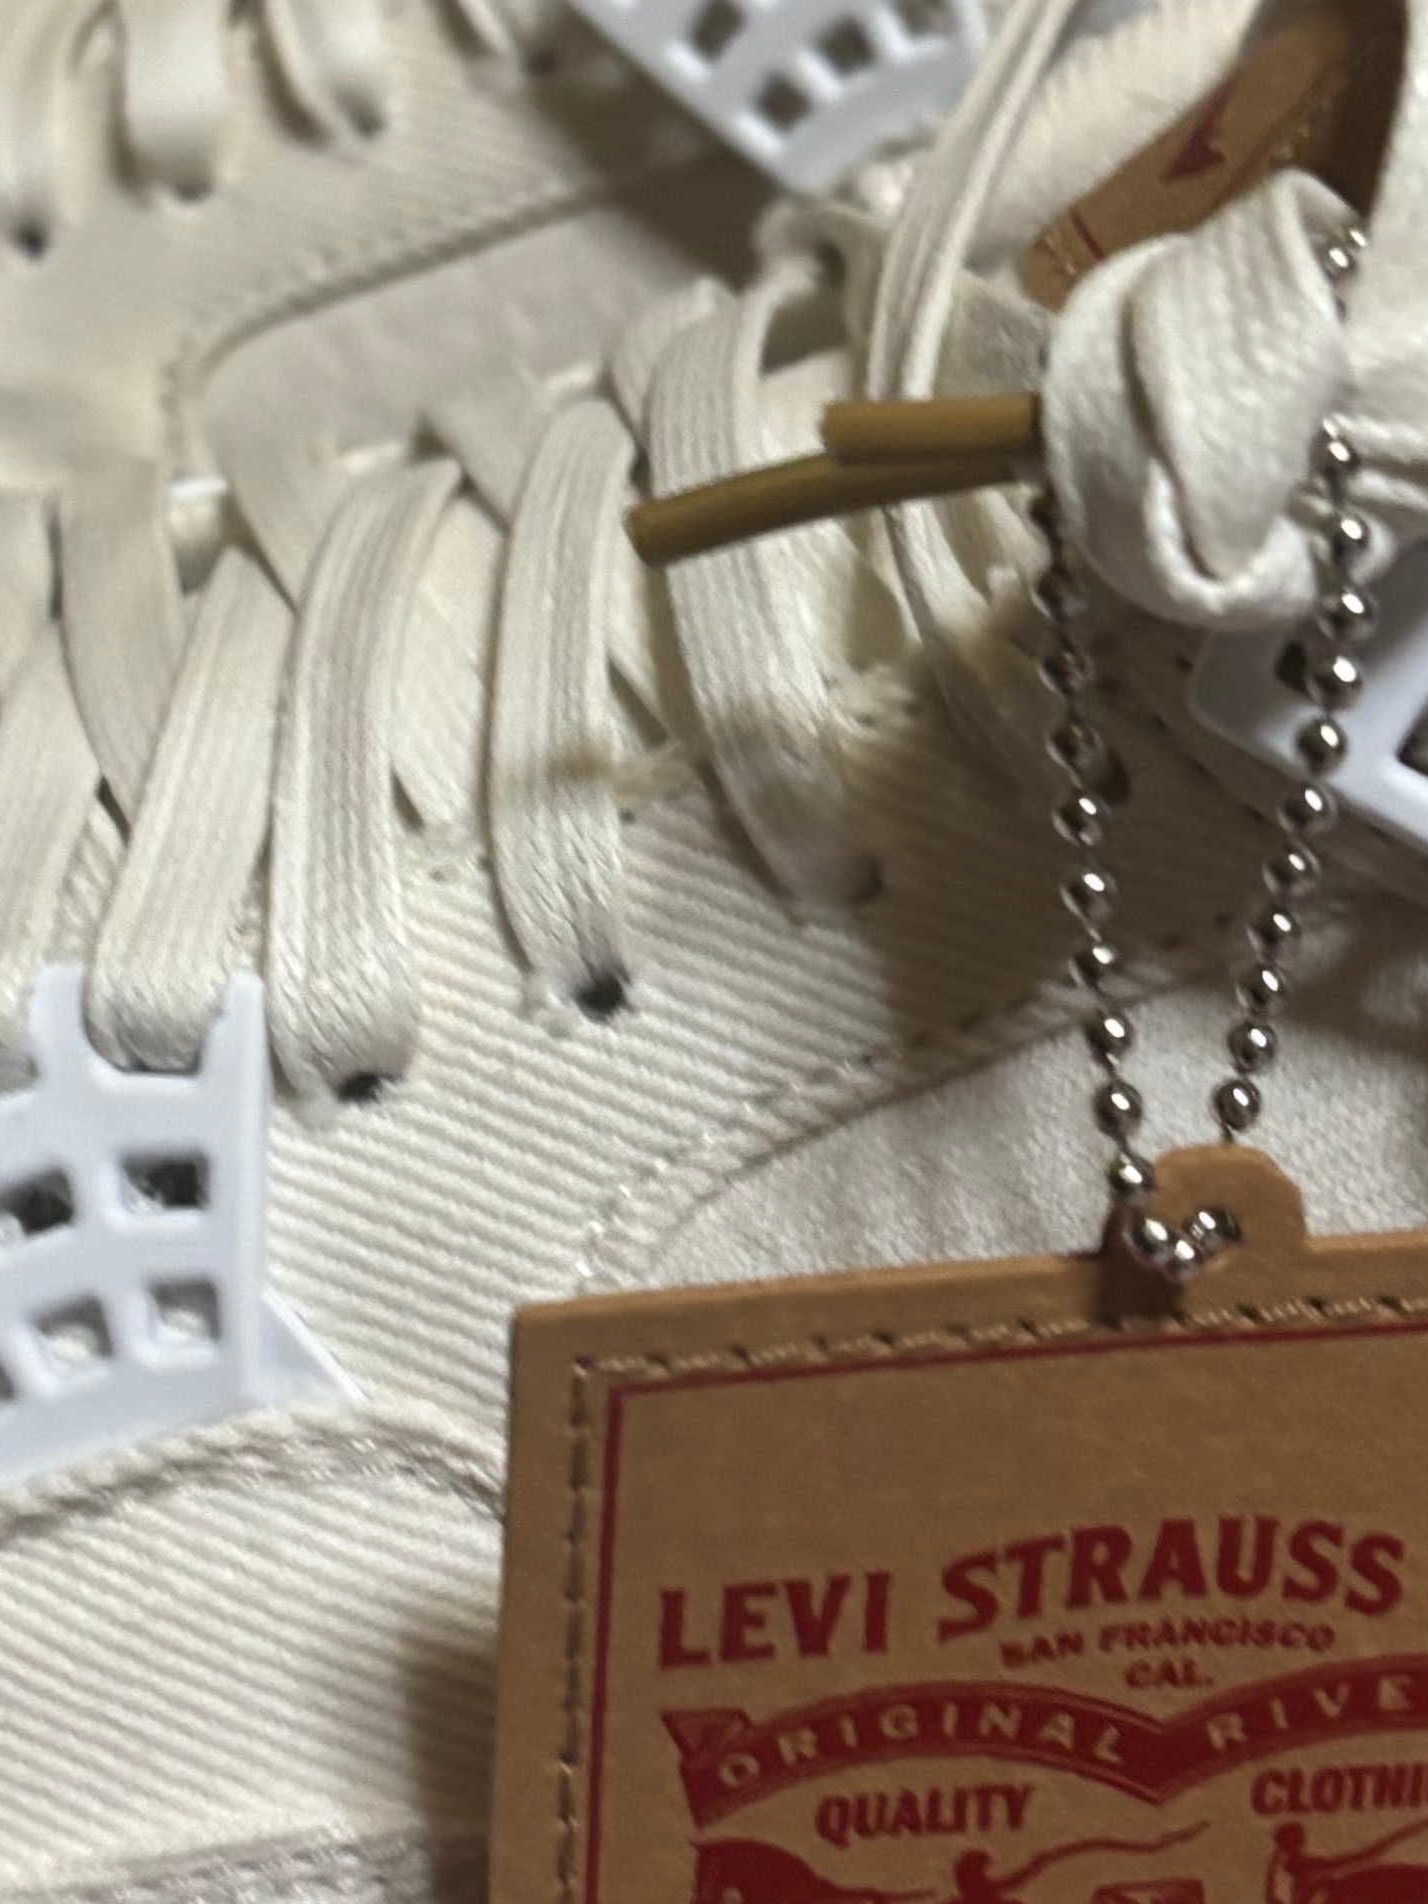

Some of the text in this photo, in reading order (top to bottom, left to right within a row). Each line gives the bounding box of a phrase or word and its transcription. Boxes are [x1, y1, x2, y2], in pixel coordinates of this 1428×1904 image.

[658, 1571, 892, 1670] LEVI
[937, 1516, 1405, 1642] STRAUSS
[1001, 1615, 1336, 1670] SAN FRANCISCO
[1125, 1658, 1215, 1689] CAL.
[717, 1702, 1125, 1788] ORIGINAL
[814, 1783, 1036, 1849] QUALITY
